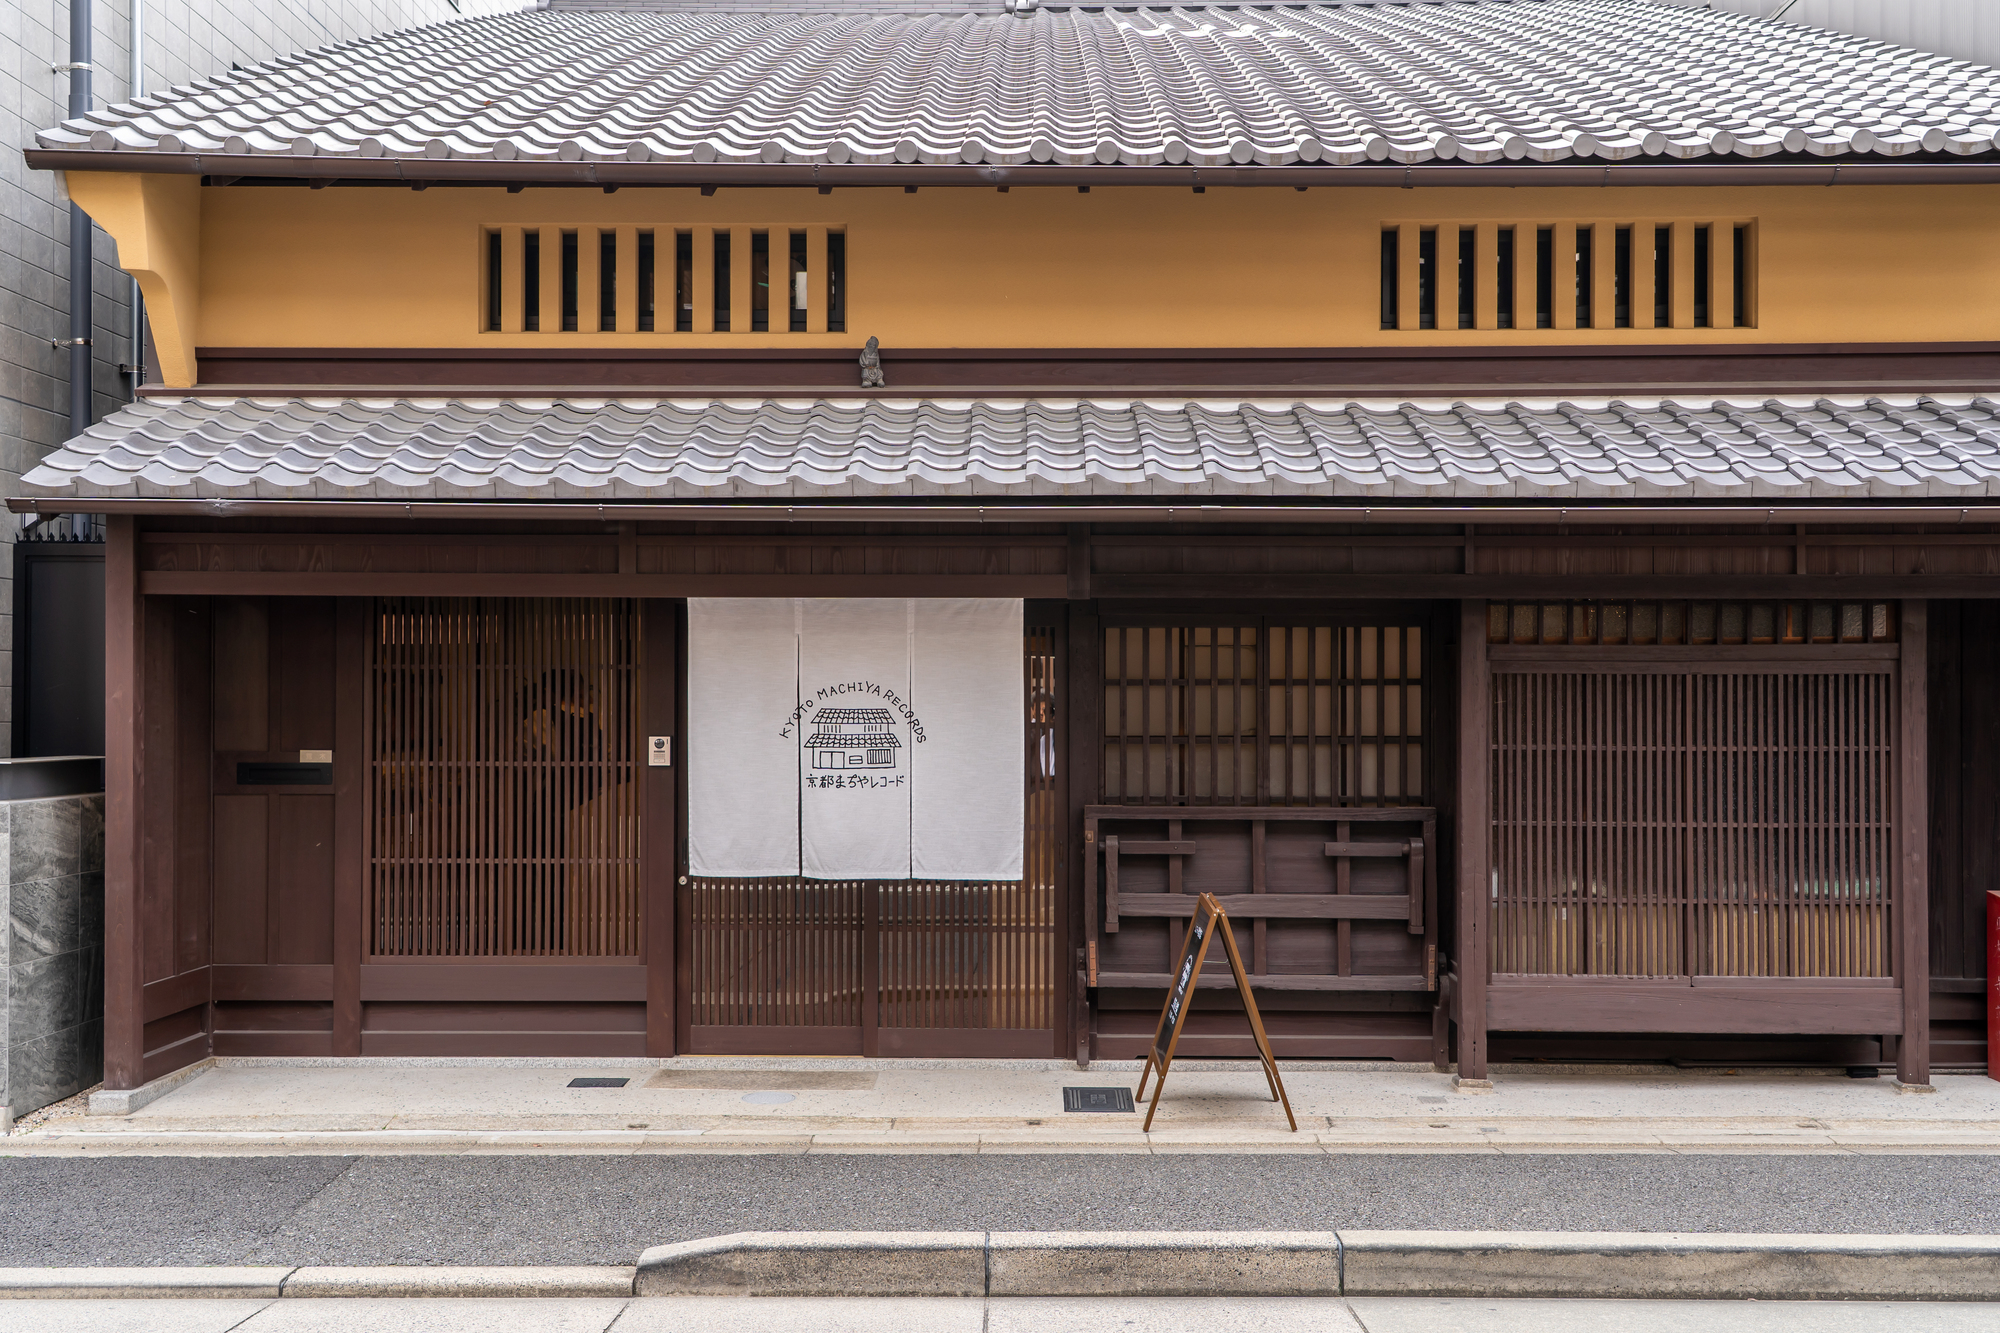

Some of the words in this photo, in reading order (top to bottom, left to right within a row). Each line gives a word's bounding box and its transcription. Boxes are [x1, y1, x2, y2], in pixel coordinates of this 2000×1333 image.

[779, 700, 814, 739] KYOTO
[817, 681, 880, 700] MACHIYA
[883, 689, 926, 743] RECORDS
[805, 774, 905, 789] 京都まちやレコード
